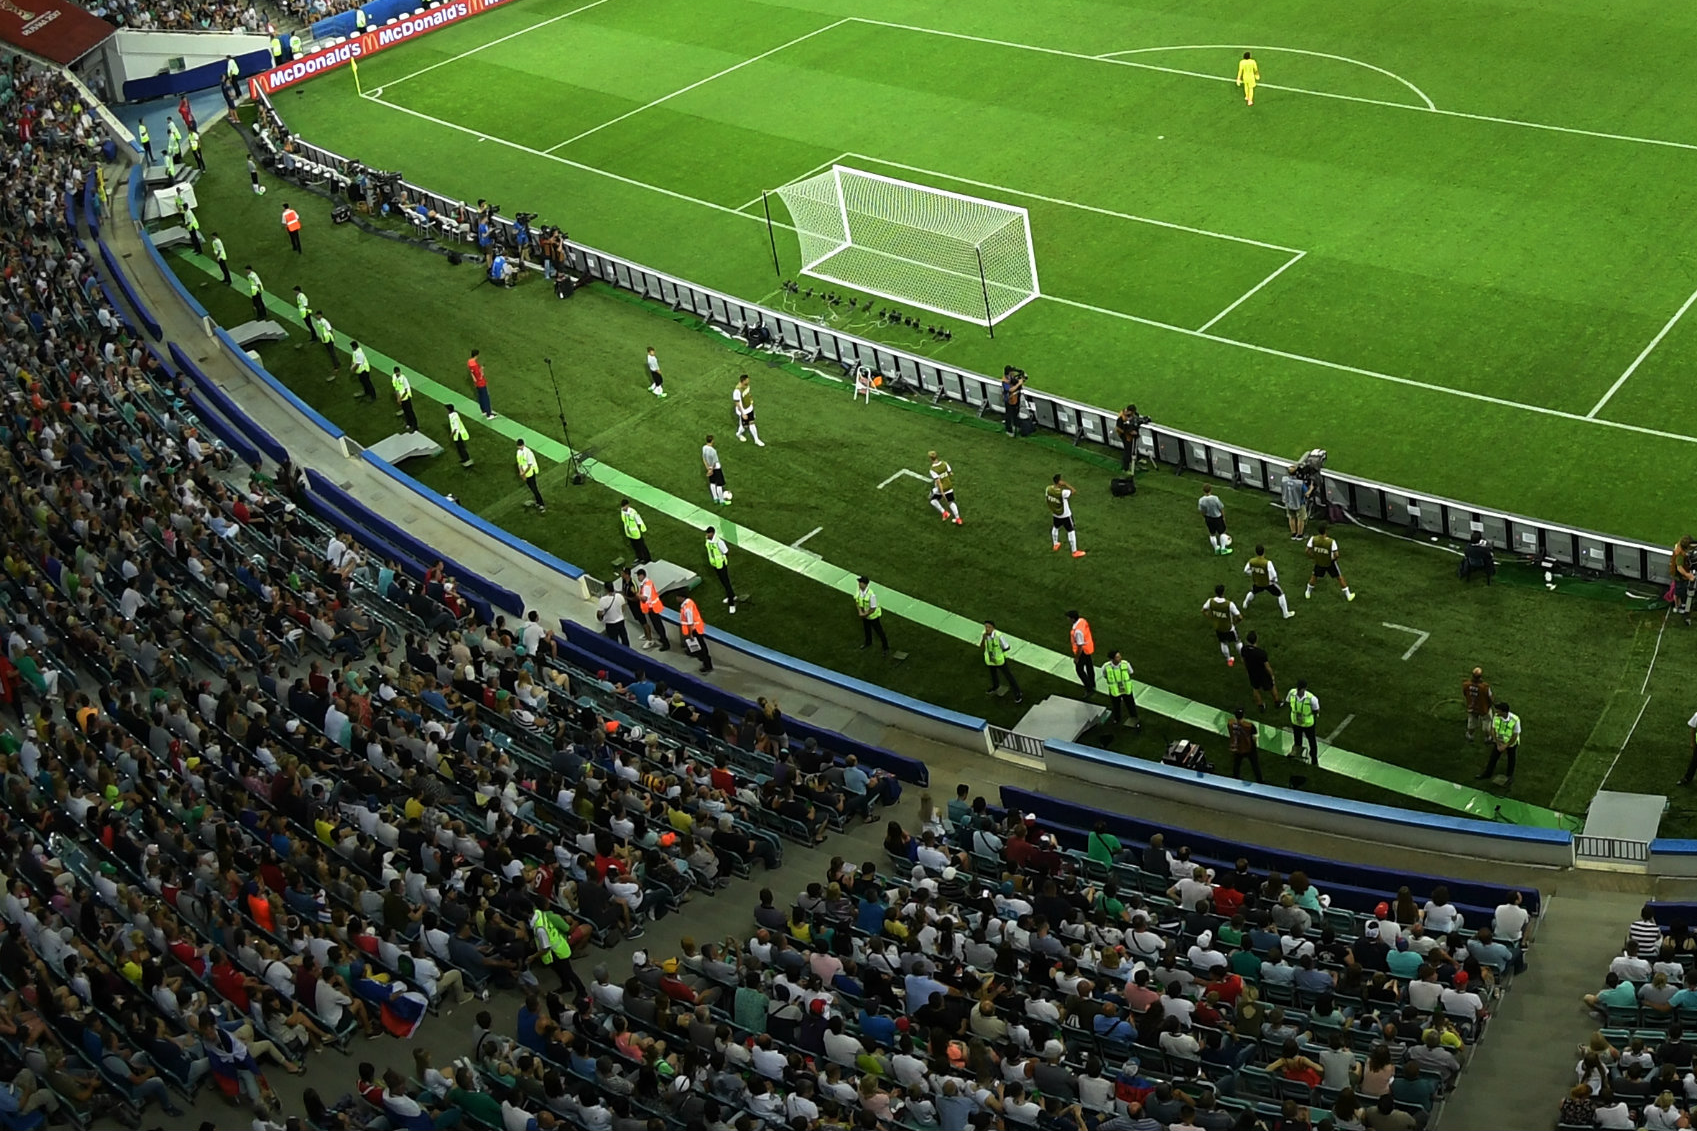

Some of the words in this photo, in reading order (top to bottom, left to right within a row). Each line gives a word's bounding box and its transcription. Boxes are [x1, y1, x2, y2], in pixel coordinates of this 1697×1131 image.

[270, 40, 361, 88] McDonald's
[380, 0, 468, 44] McDonald's
[1314, 546, 1329, 554] FIFA
